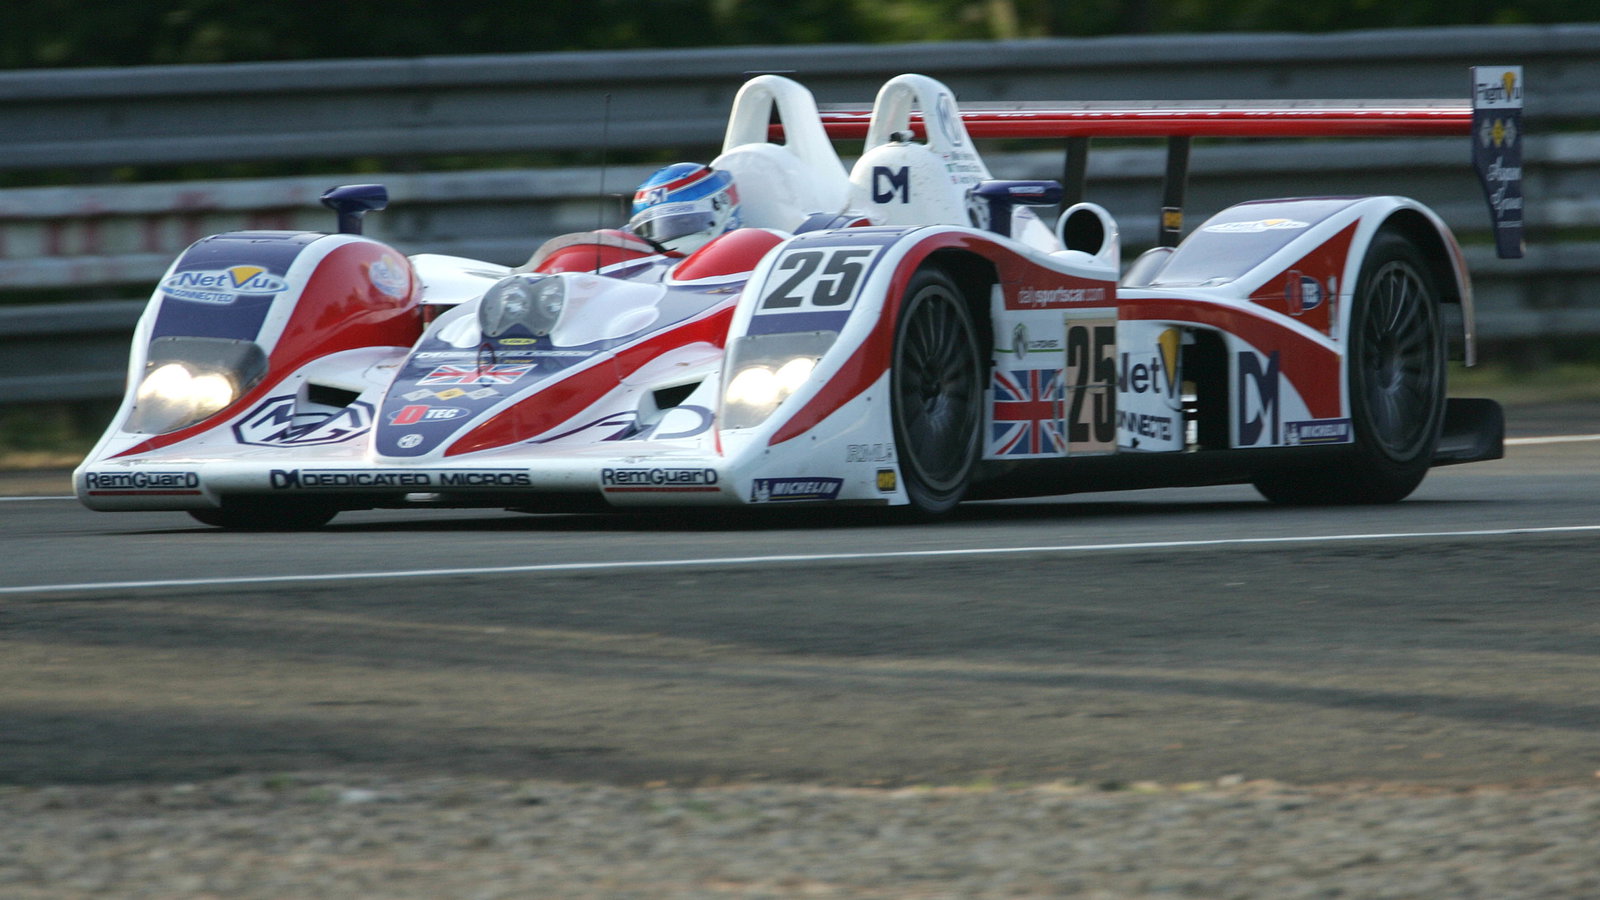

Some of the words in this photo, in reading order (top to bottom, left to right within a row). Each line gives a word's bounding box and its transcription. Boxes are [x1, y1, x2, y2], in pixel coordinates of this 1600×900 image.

[177, 267, 270, 289] NetVu
[763, 251, 864, 309] 25
[1067, 326, 1116, 443] 25
[303, 473, 431, 487] DEDICATED
[440, 473, 532, 486] MICROS
[771, 482, 838, 495] MICHELIN
